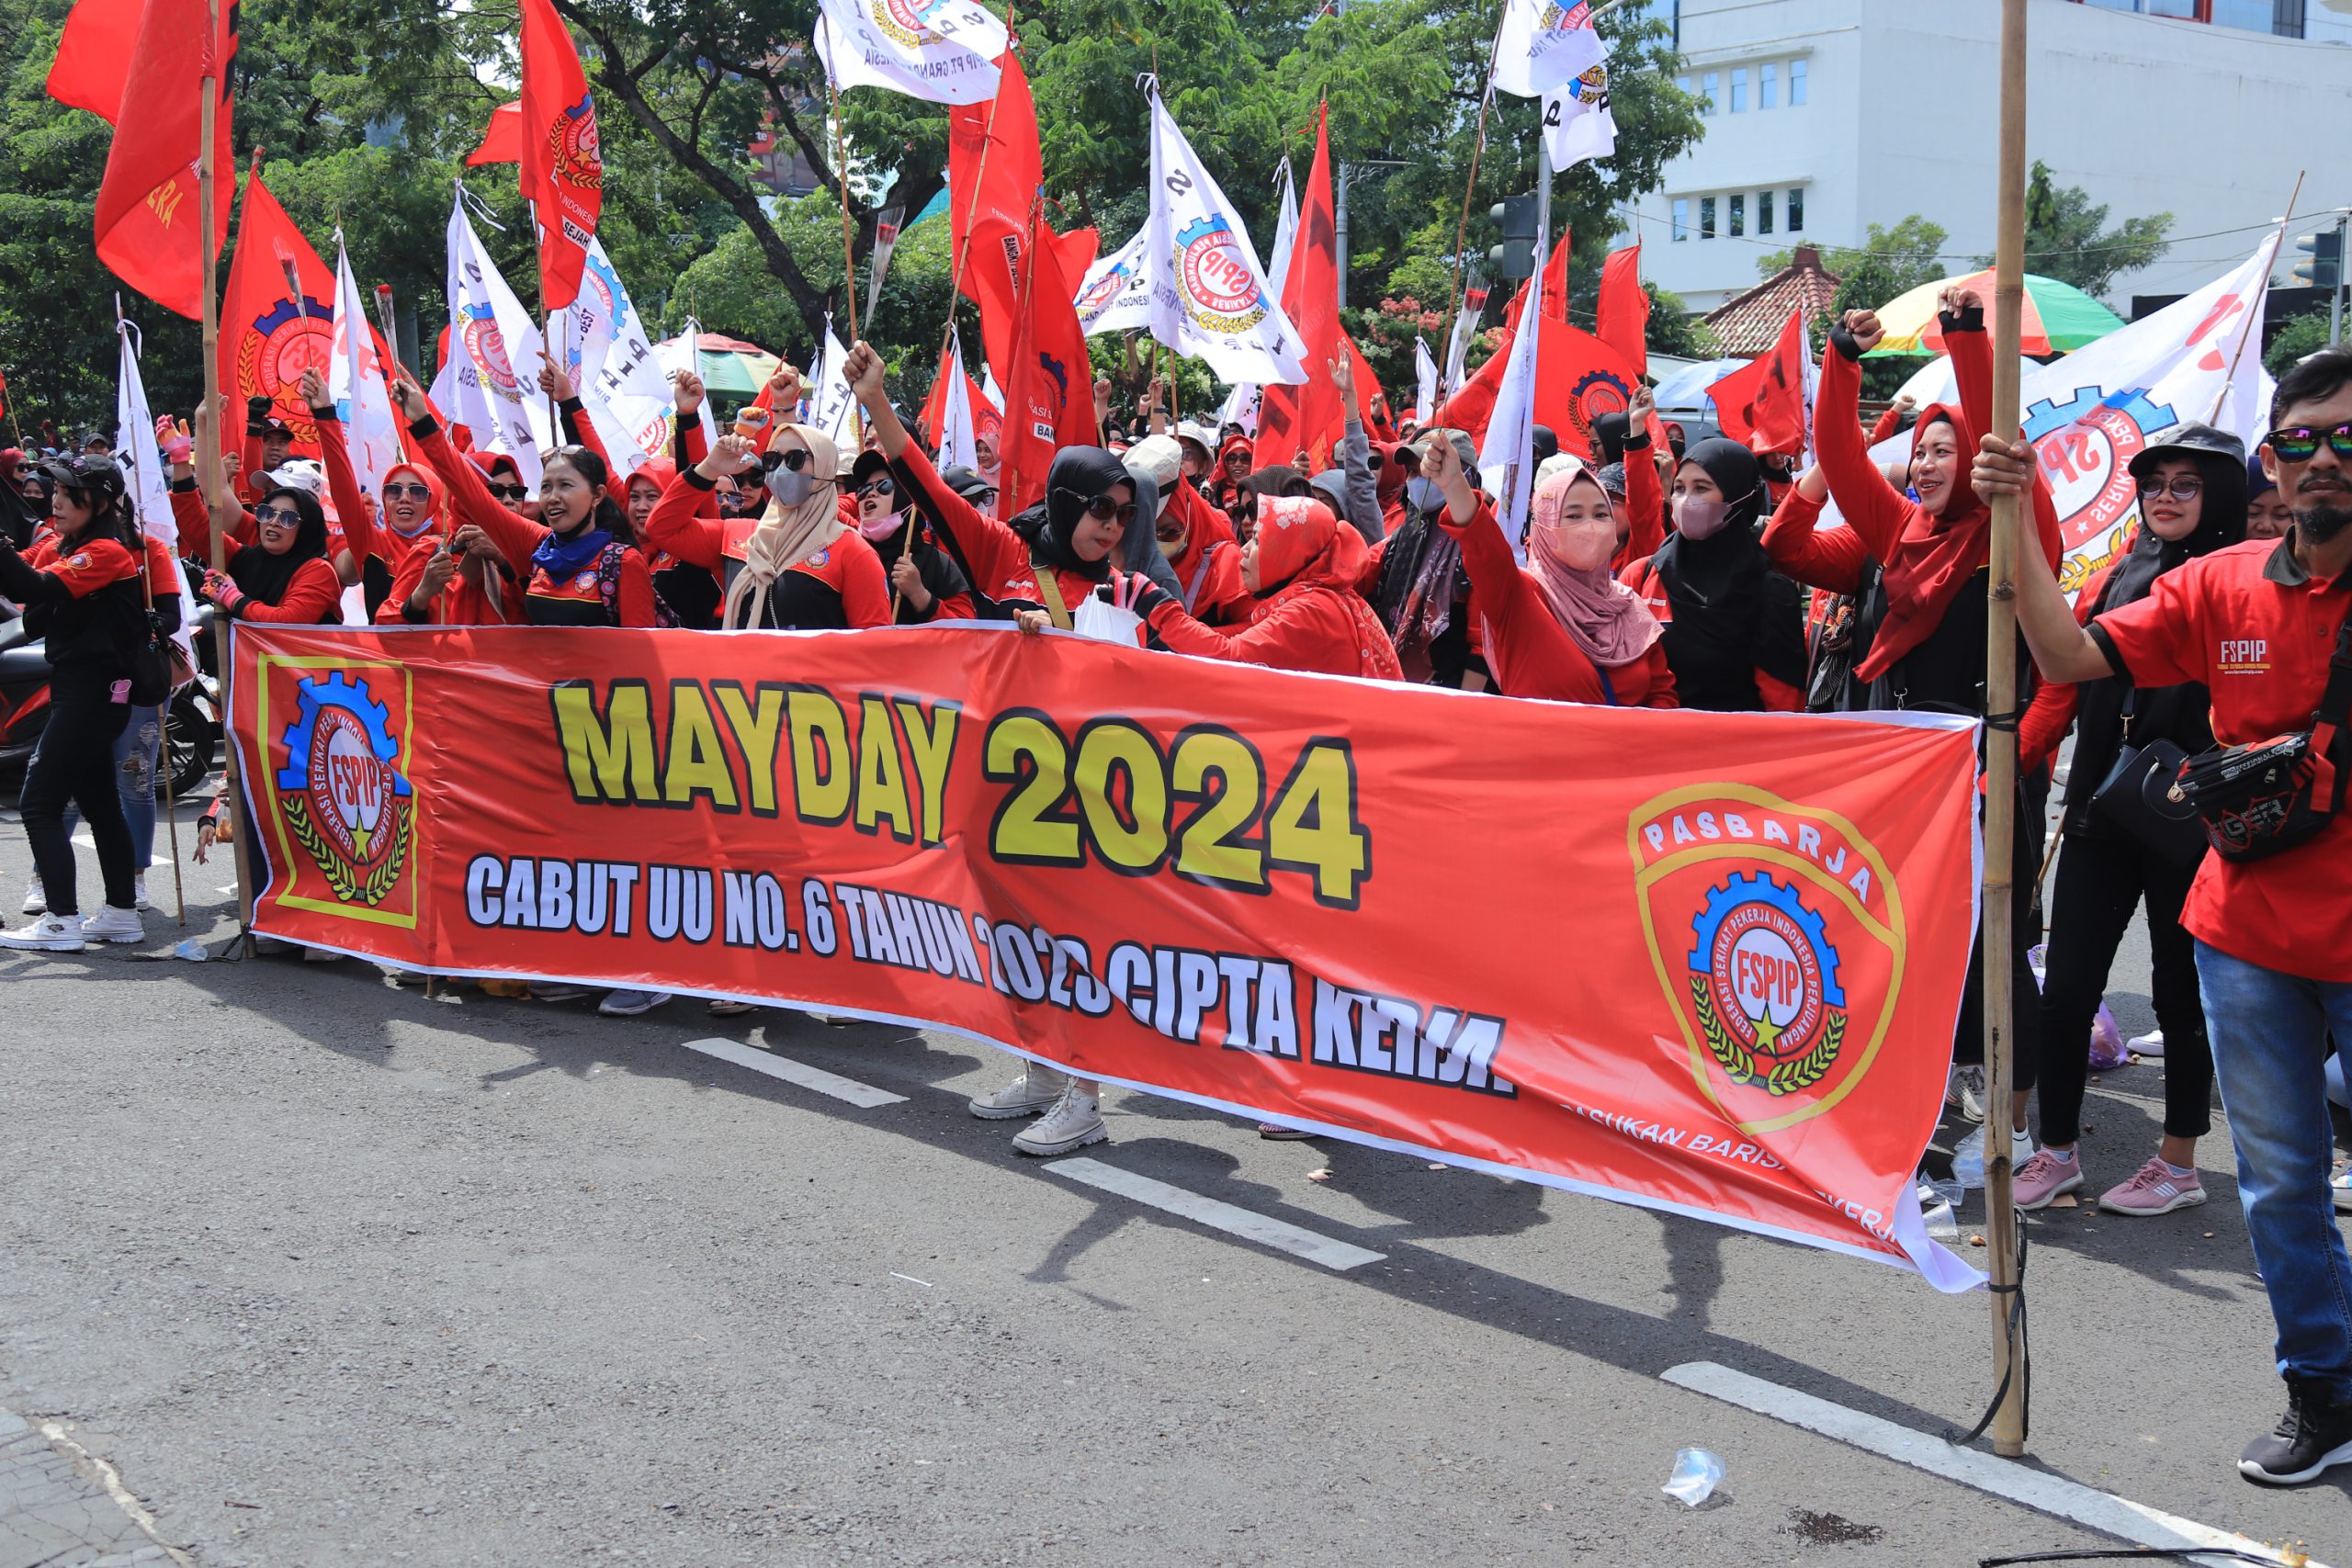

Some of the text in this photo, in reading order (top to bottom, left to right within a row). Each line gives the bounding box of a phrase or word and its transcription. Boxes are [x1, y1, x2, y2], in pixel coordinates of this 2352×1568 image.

[561, 196, 596, 229] INDONESIA
[563, 221, 592, 250] SEJAH
[1116, 295, 1150, 309] INDONESI
[2221, 639, 2267, 663] FSPIP
[314, 734, 327, 792] SERIKAT
[331, 754, 378, 807] FSPIP
[320, 794, 353, 852] FEDERASI
[551, 678, 1373, 911] MAYDAY 2024
[1644, 811, 1872, 904] PASBARJA
[465, 853, 639, 938] CABUT
[644, 863, 718, 944] UU
[718, 869, 800, 953] NO.
[802, 877, 839, 958] 6
[834, 882, 986, 987] TAHUN
[1108, 939, 1300, 1062] CIPTA
[1715, 908, 1818, 1048] FEDERASI SERIKAT PEKERJA INDONESIA PERJUANGAN
[1737, 949, 1799, 1007] FSPIP
